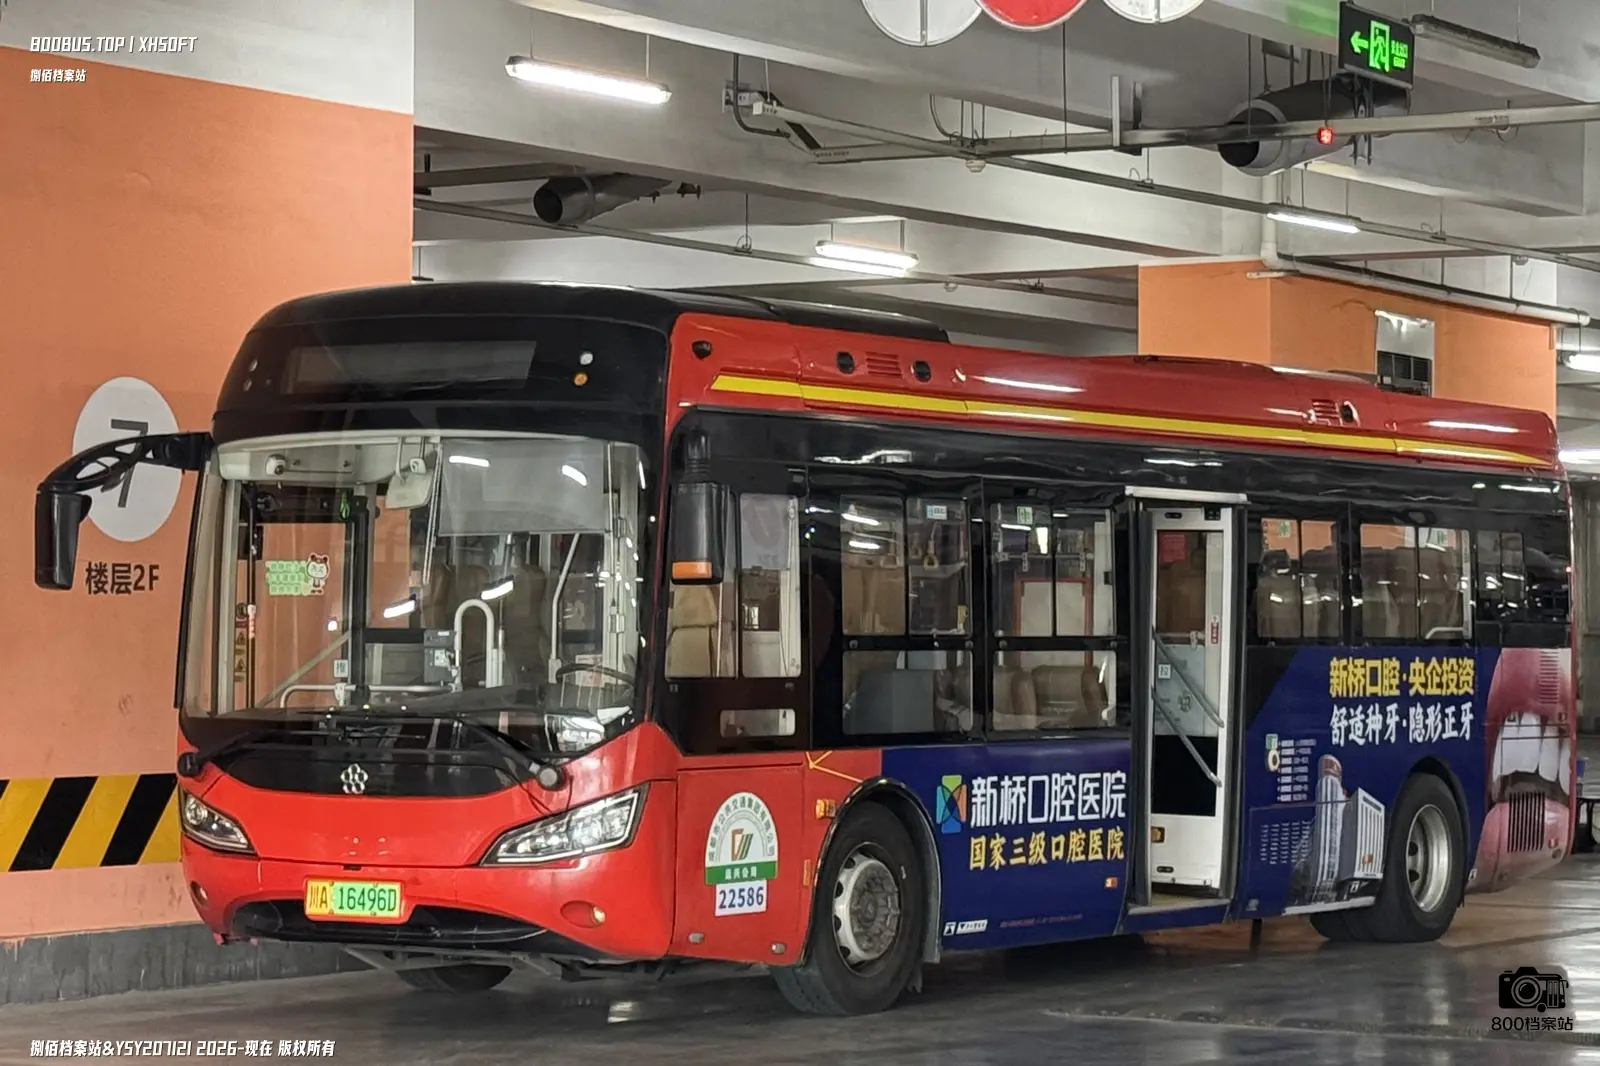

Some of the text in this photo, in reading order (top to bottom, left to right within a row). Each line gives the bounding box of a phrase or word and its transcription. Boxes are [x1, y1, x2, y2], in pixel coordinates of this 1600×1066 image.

[111, 418, 148, 508] 7
[85, 561, 160, 595] 楼层2F
[1329, 656, 1475, 698] 新桥口腔·央企投资
[1329, 701, 1475, 747] 舒适种牙·隐形正牙
[970, 770, 1127, 828] 新桥口腔医院
[969, 826, 1125, 871] 国家三级口腔医院
[718, 886, 765, 910] 22586
